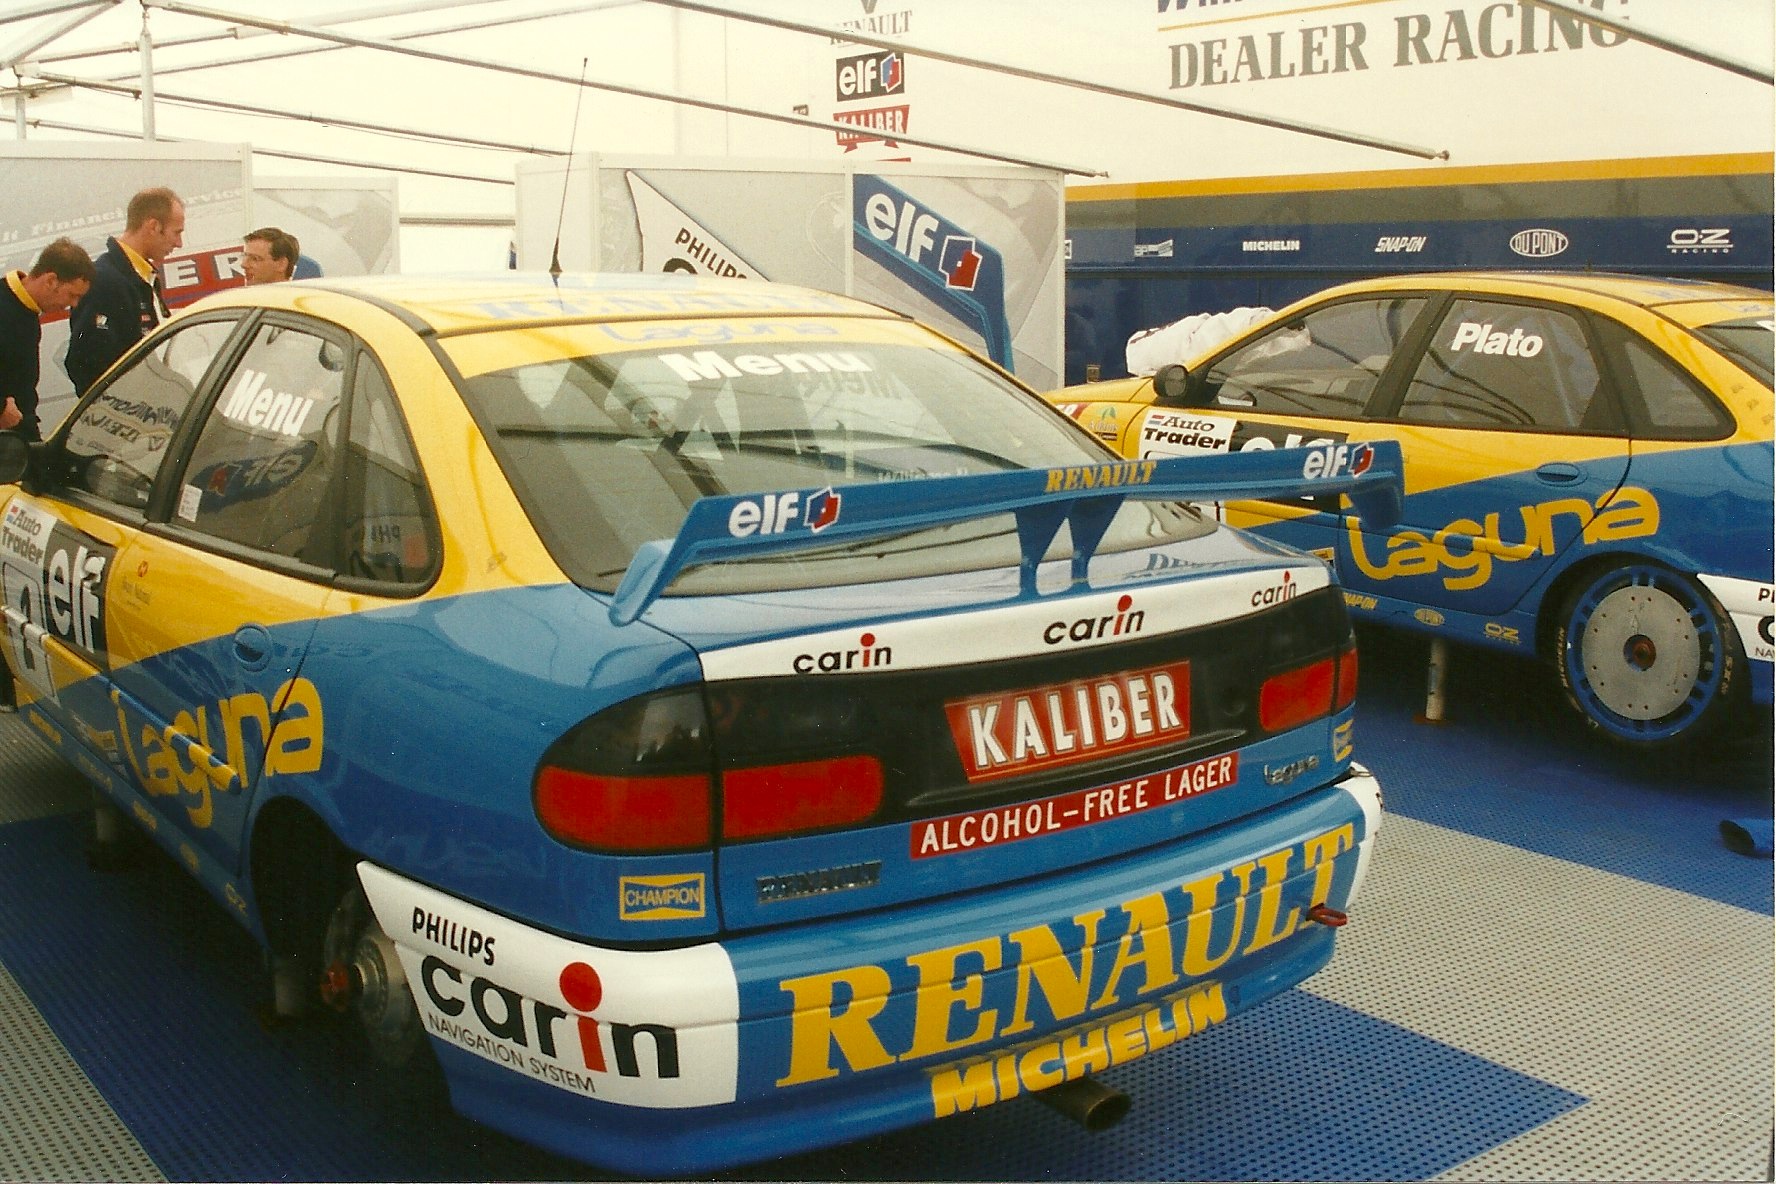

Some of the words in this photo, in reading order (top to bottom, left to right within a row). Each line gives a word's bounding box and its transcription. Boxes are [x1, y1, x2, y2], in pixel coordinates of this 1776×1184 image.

[1168, 22, 1369, 90] DEALER
[1393, 0, 1630, 67] RACING
[839, 59, 877, 95] elf
[863, 191, 939, 264] elf
[1243, 240, 1300, 251] MICHELIN
[1451, 322, 1543, 357] Plato
[657, 350, 873, 381] Menu
[225, 369, 313, 437] Menu
[1161, 415, 1215, 432] Auto
[1144, 427, 1227, 450] Trader
[1045, 461, 1157, 493] RENAULT
[1303, 444, 1348, 480] elf
[13, 509, 42, 536] Auto
[729, 492, 798, 538] elf
[2, 526, 44, 565] Trader
[49, 545, 106, 653] elf
[1251, 570, 1297, 606] carin
[1043, 594, 1145, 645] carin
[793, 632, 892, 675] carin
[966, 673, 1183, 769] KALIBER
[920, 782, 1149, 854] ALCOHOL-FREE
[1163, 756, 1233, 803] LAGER
[625, 887, 700, 907] CHAMPION
[412, 907, 495, 965] PHILIPS
[776, 823, 1355, 1088] RENAULT
[421, 955, 679, 1078] carin
[428, 1011, 523, 1067] NAVIGATION
[529, 1056, 596, 1092] SYSTEM
[930, 982, 1228, 1119] MICHELIN
